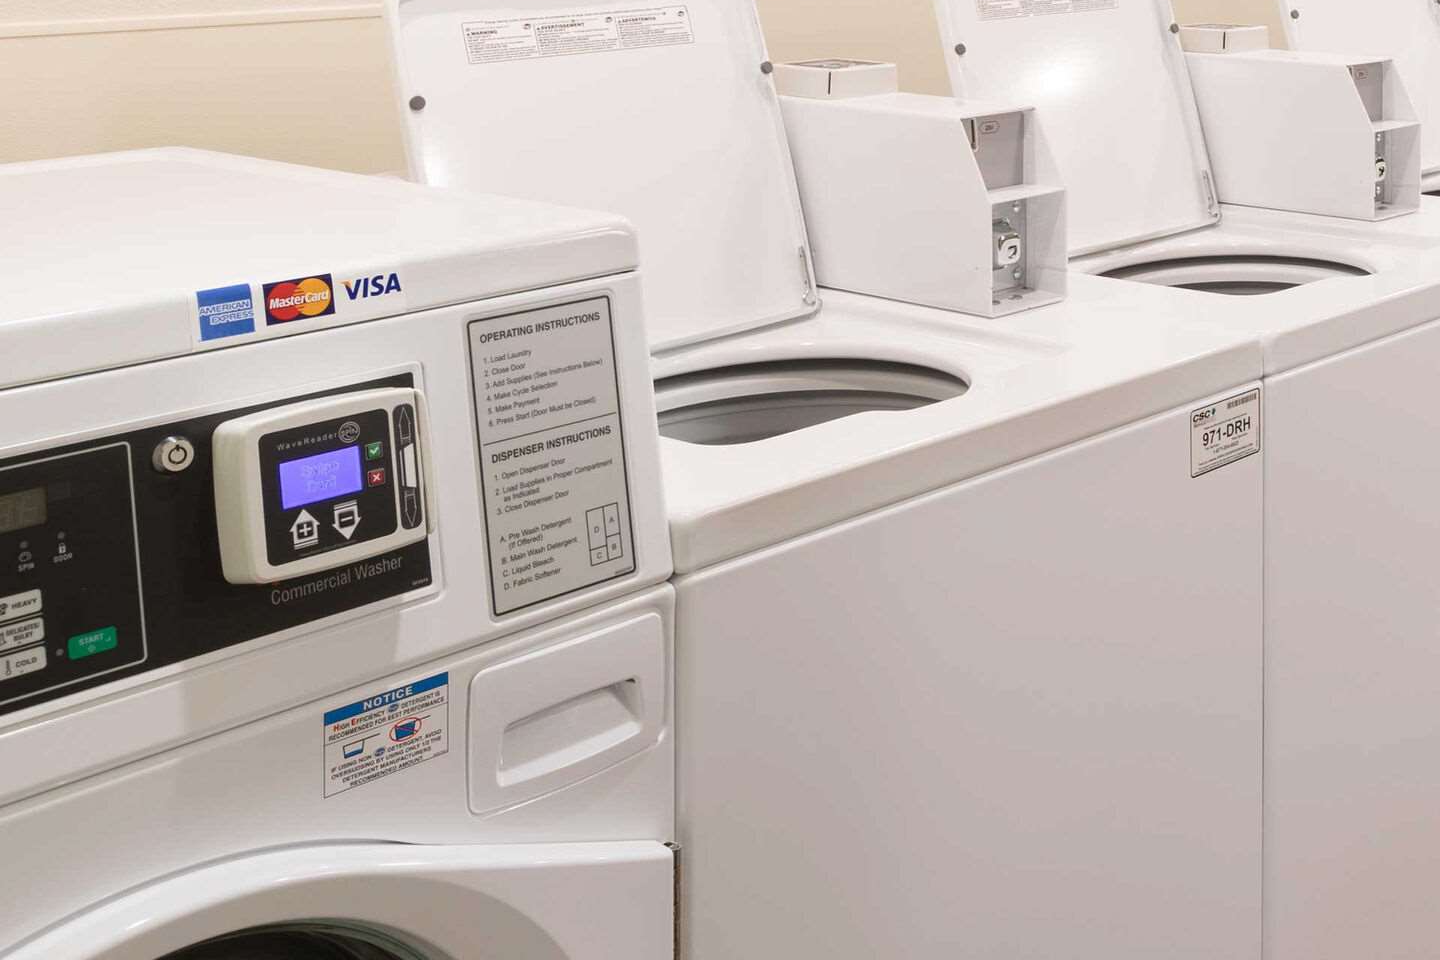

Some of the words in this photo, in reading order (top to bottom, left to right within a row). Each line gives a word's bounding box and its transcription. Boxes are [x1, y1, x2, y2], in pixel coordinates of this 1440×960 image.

[339, 273, 402, 300] VISA
[200, 298, 250, 316] AMERICAN
[269, 289, 330, 310] MasterCard
[210, 310, 253, 326] EXPRESS
[480, 324, 533, 344] OPERATING
[535, 311, 601, 333] INSTRUCTIONS
[490, 354, 506, 364] Load
[507, 349, 532, 360] Laundry
[486, 382, 490, 390] 3.
[493, 378, 505, 388] Add
[507, 374, 532, 386] Supplies
[534, 371, 548, 382] (See
[583, 358, 603, 369] Below)
[491, 367, 510, 376] Close
[511, 362, 526, 372] Door
[486, 394, 492, 402] 4.
[494, 392, 511, 400] Make
[512, 388, 529, 398] Cycle
[530, 380, 558, 392] Selection
[495, 404, 512, 414] Make
[514, 397, 540, 410] Payment
[496, 416, 514, 425] Press
[516, 412, 530, 421] Start
[531, 408, 548, 419] (Door
[549, 404, 564, 413] Must
[564, 402, 572, 410] be
[574, 396, 596, 408] Closed)
[1193, 410, 1210, 422] CSC
[276, 432, 338, 451] WaveReader
[1203, 416, 1251, 446] 971-DRH
[491, 443, 545, 464] DISPENSER
[546, 425, 612, 450] INSTRUCTIONS
[494, 474, 500, 482] 1.
[502, 470, 519, 481] Open
[520, 463, 550, 476] Dispenser
[551, 458, 566, 466] Door
[495, 488, 501, 496] 2.
[502, 484, 518, 494] Load
[520, 477, 546, 490] Supplies
[547, 474, 552, 482] in
[553, 470, 573, 482] Proper
[574, 459, 613, 475] Compartment
[504, 503, 522, 514] Close
[524, 496, 552, 509] Dispenser
[554, 490, 570, 500] Door
[508, 532, 520, 541] Pre
[521, 526, 540, 538] Wash
[540, 517, 572, 532] Detergent
[594, 526, 600, 534] D
[608, 516, 615, 524] A
[510, 552, 526, 562] Main
[528, 546, 546, 558] Wash
[546, 536, 578, 552] Detergent
[516, 534, 544, 548] Offered)
[596, 552, 602, 560] C
[502, 570, 510, 578] C.
[511, 564, 532, 576] Liquid
[532, 556, 554, 568] Bleach
[271, 569, 352, 605] Commercial
[353, 554, 403, 581] Washer
[504, 582, 512, 590] D.
[512, 576, 534, 588] Fabric
[534, 568, 562, 582] Softener
[11, 598, 38, 610] HEAVY
[79, 633, 105, 647] START
[15, 657, 37, 668] COLD
[363, 686, 414, 711] NOTICE
[328, 724, 374, 742] RECOMMENDED
[374, 717, 388, 726] FOR
[388, 712, 402, 722] BEST
[403, 696, 444, 717] PERFORMANCE
[351, 710, 385, 727] EFFICIENCY
[400, 693, 434, 709] DETERGENT
[338, 760, 358, 771] USING
[358, 754, 372, 764] NON
[376, 756, 384, 764] BY
[386, 750, 404, 760] USING
[342, 765, 378, 784] DETERGENT
[350, 766, 398, 787] RECOMMENDED
